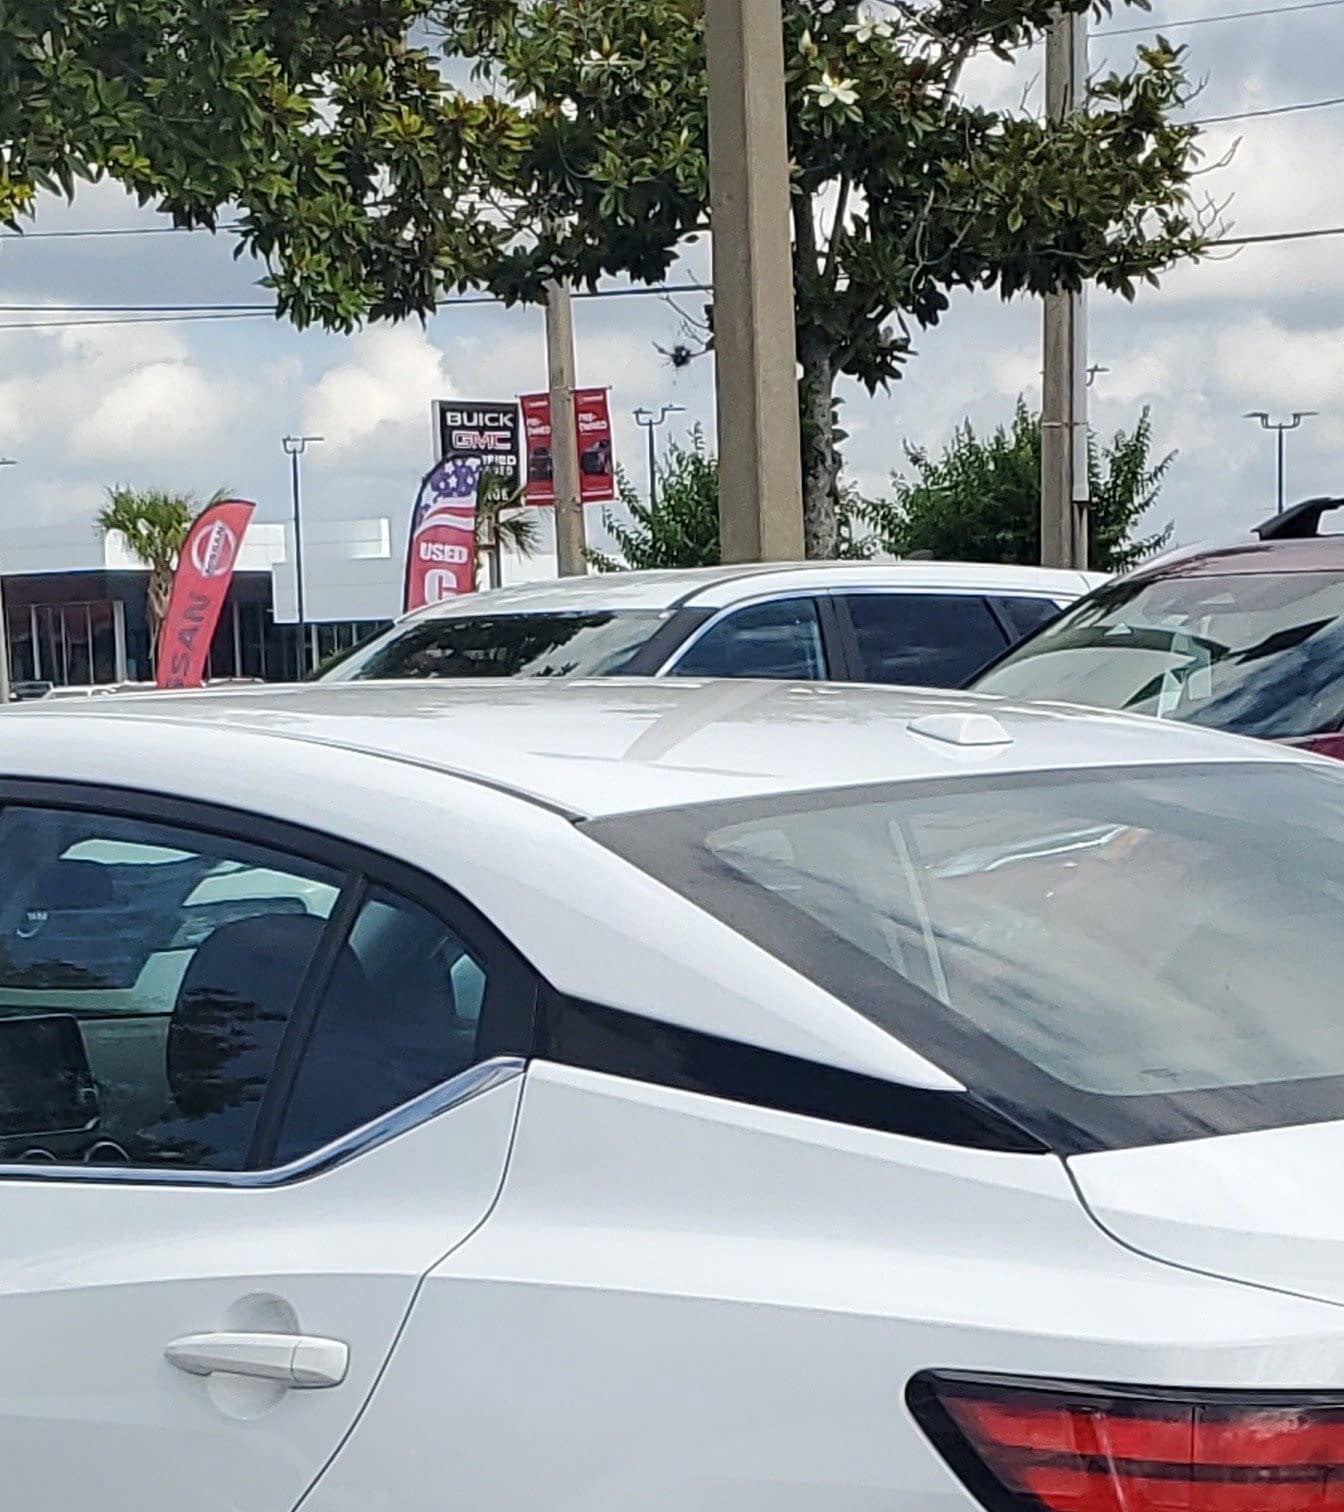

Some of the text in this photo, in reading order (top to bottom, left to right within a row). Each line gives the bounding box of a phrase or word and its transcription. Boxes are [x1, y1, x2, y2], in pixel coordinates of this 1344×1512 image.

[445, 411, 515, 428] BUICK
[452, 430, 512, 450] GMC
[419, 542, 469, 564] USED
